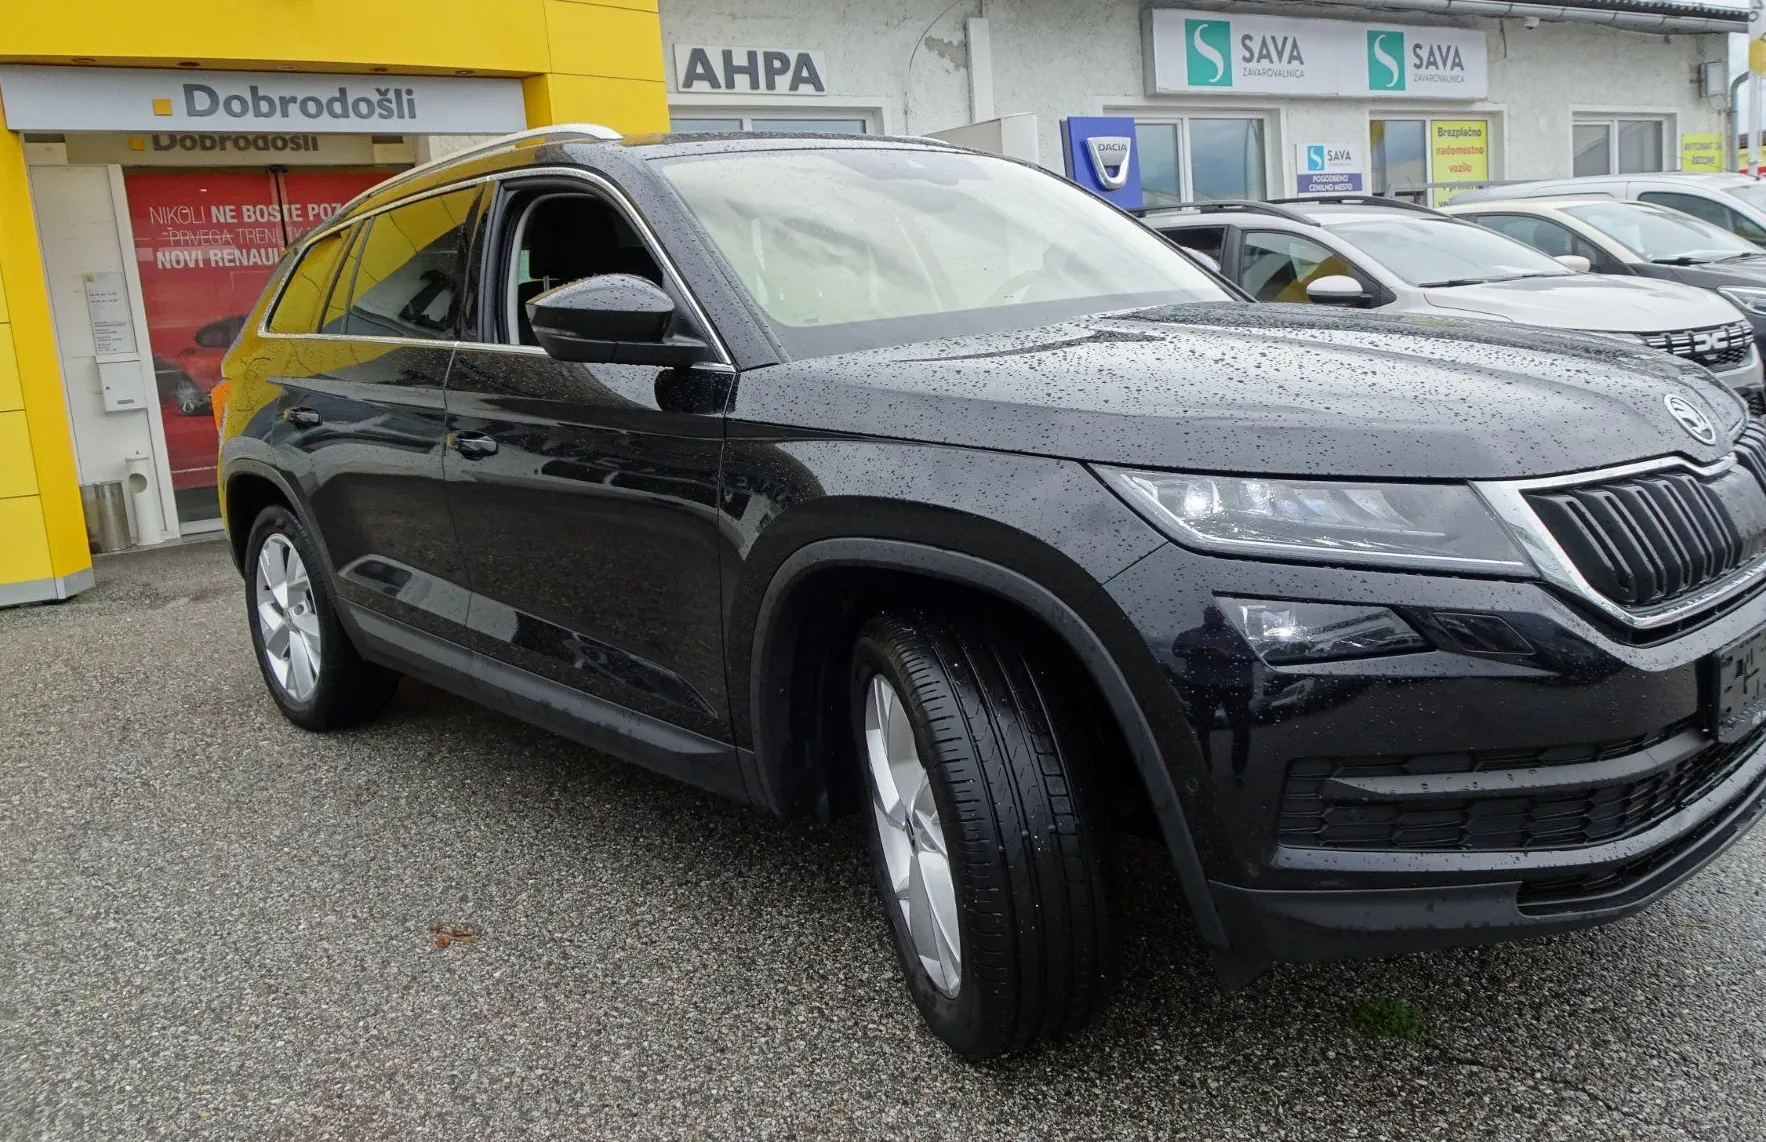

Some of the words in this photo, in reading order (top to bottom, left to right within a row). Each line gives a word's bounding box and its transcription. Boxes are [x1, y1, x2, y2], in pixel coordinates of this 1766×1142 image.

[1240, 33, 1304, 65] SAVA
[1412, 43, 1464, 71] SAVA
[682, 47, 826, 92] AHPA
[1242, 66, 1305, 79] ZAVAROVALNICA
[1413, 73, 1465, 84] ZAVAROVALNICA
[182, 83, 417, 120] Dobrodošli
[1437, 126, 1482, 139] Brezplačno
[1098, 143, 1127, 152] DACIA
[1435, 144, 1484, 155] nadomestno
[1327, 149, 1352, 161] SAVA
[1448, 162, 1472, 173] vozilo
[1312, 174, 1349, 183] POGODBENO
[1334, 183, 1353, 191] MESTO
[150, 206, 206, 224] NIKOLI
[210, 205, 237, 223] NE
[242, 204, 303, 223] BOSTE
[169, 229, 235, 247] PRVEGA
[156, 249, 204, 270] NOVI
